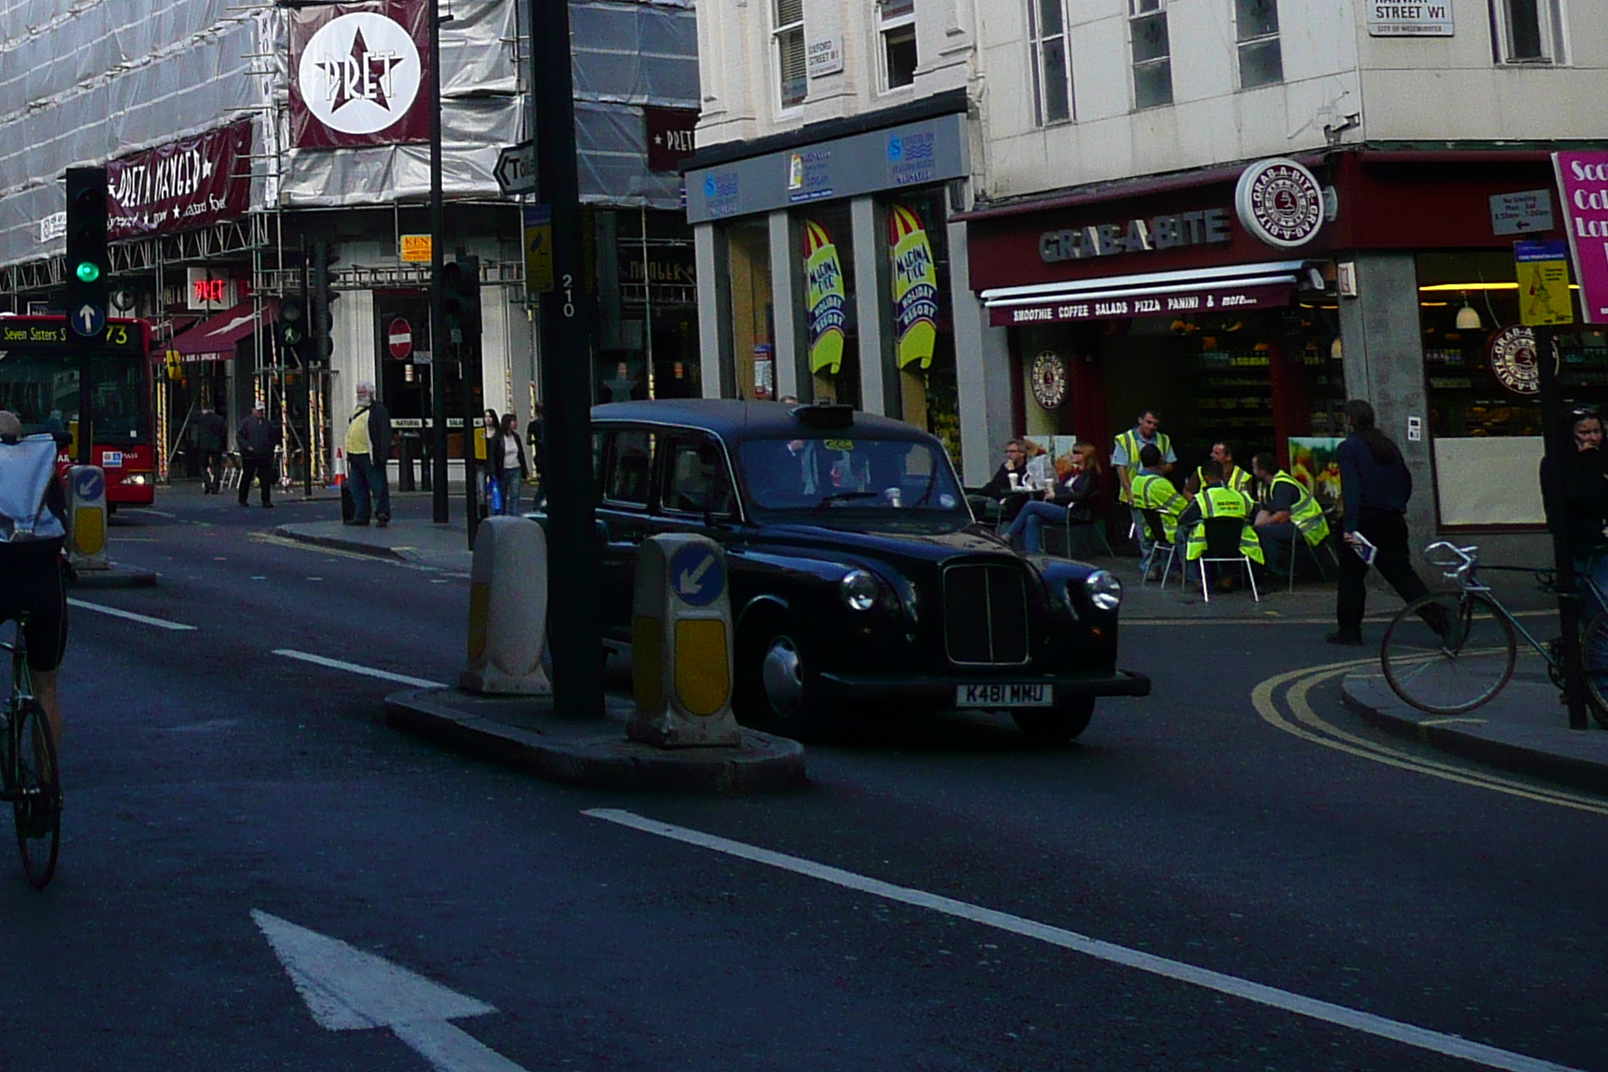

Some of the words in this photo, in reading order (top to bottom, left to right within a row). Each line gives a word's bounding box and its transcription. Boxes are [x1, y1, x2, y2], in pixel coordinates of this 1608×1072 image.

[1376, 6, 1421, 19] STREET
[1428, 6, 1445, 19] W1
[808, 52, 829, 66] STREET
[323, 49, 395, 101] PRET
[666, 130, 692, 151] PRET
[116, 165, 146, 208] PRET
[154, 149, 201, 202] MANGER
[1039, 208, 1231, 263] GRAB-A-BITE
[196, 280, 223, 300] PRET
[901, 284, 934, 309] HOLIDAY
[814, 295, 842, 318] HOLIDAY
[903, 304, 936, 326] RESORT
[1013, 308, 1053, 322] SMOOTHIE
[1058, 305, 1089, 318] COFFEE
[1095, 302, 1128, 316] SALADS
[1134, 300, 1161, 313] PIZZA
[1167, 296, 1199, 310] PANINI
[1207, 295, 1215, 307] &
[4, 327, 27, 340] Seven
[30, 327, 57, 341] Sisters
[106, 324, 127, 344] 73
[815, 314, 843, 333] RESORT
[396, 419, 420, 427] NATURAL
[966, 685, 1006, 702] K481
[1010, 685, 1044, 702] MMU
